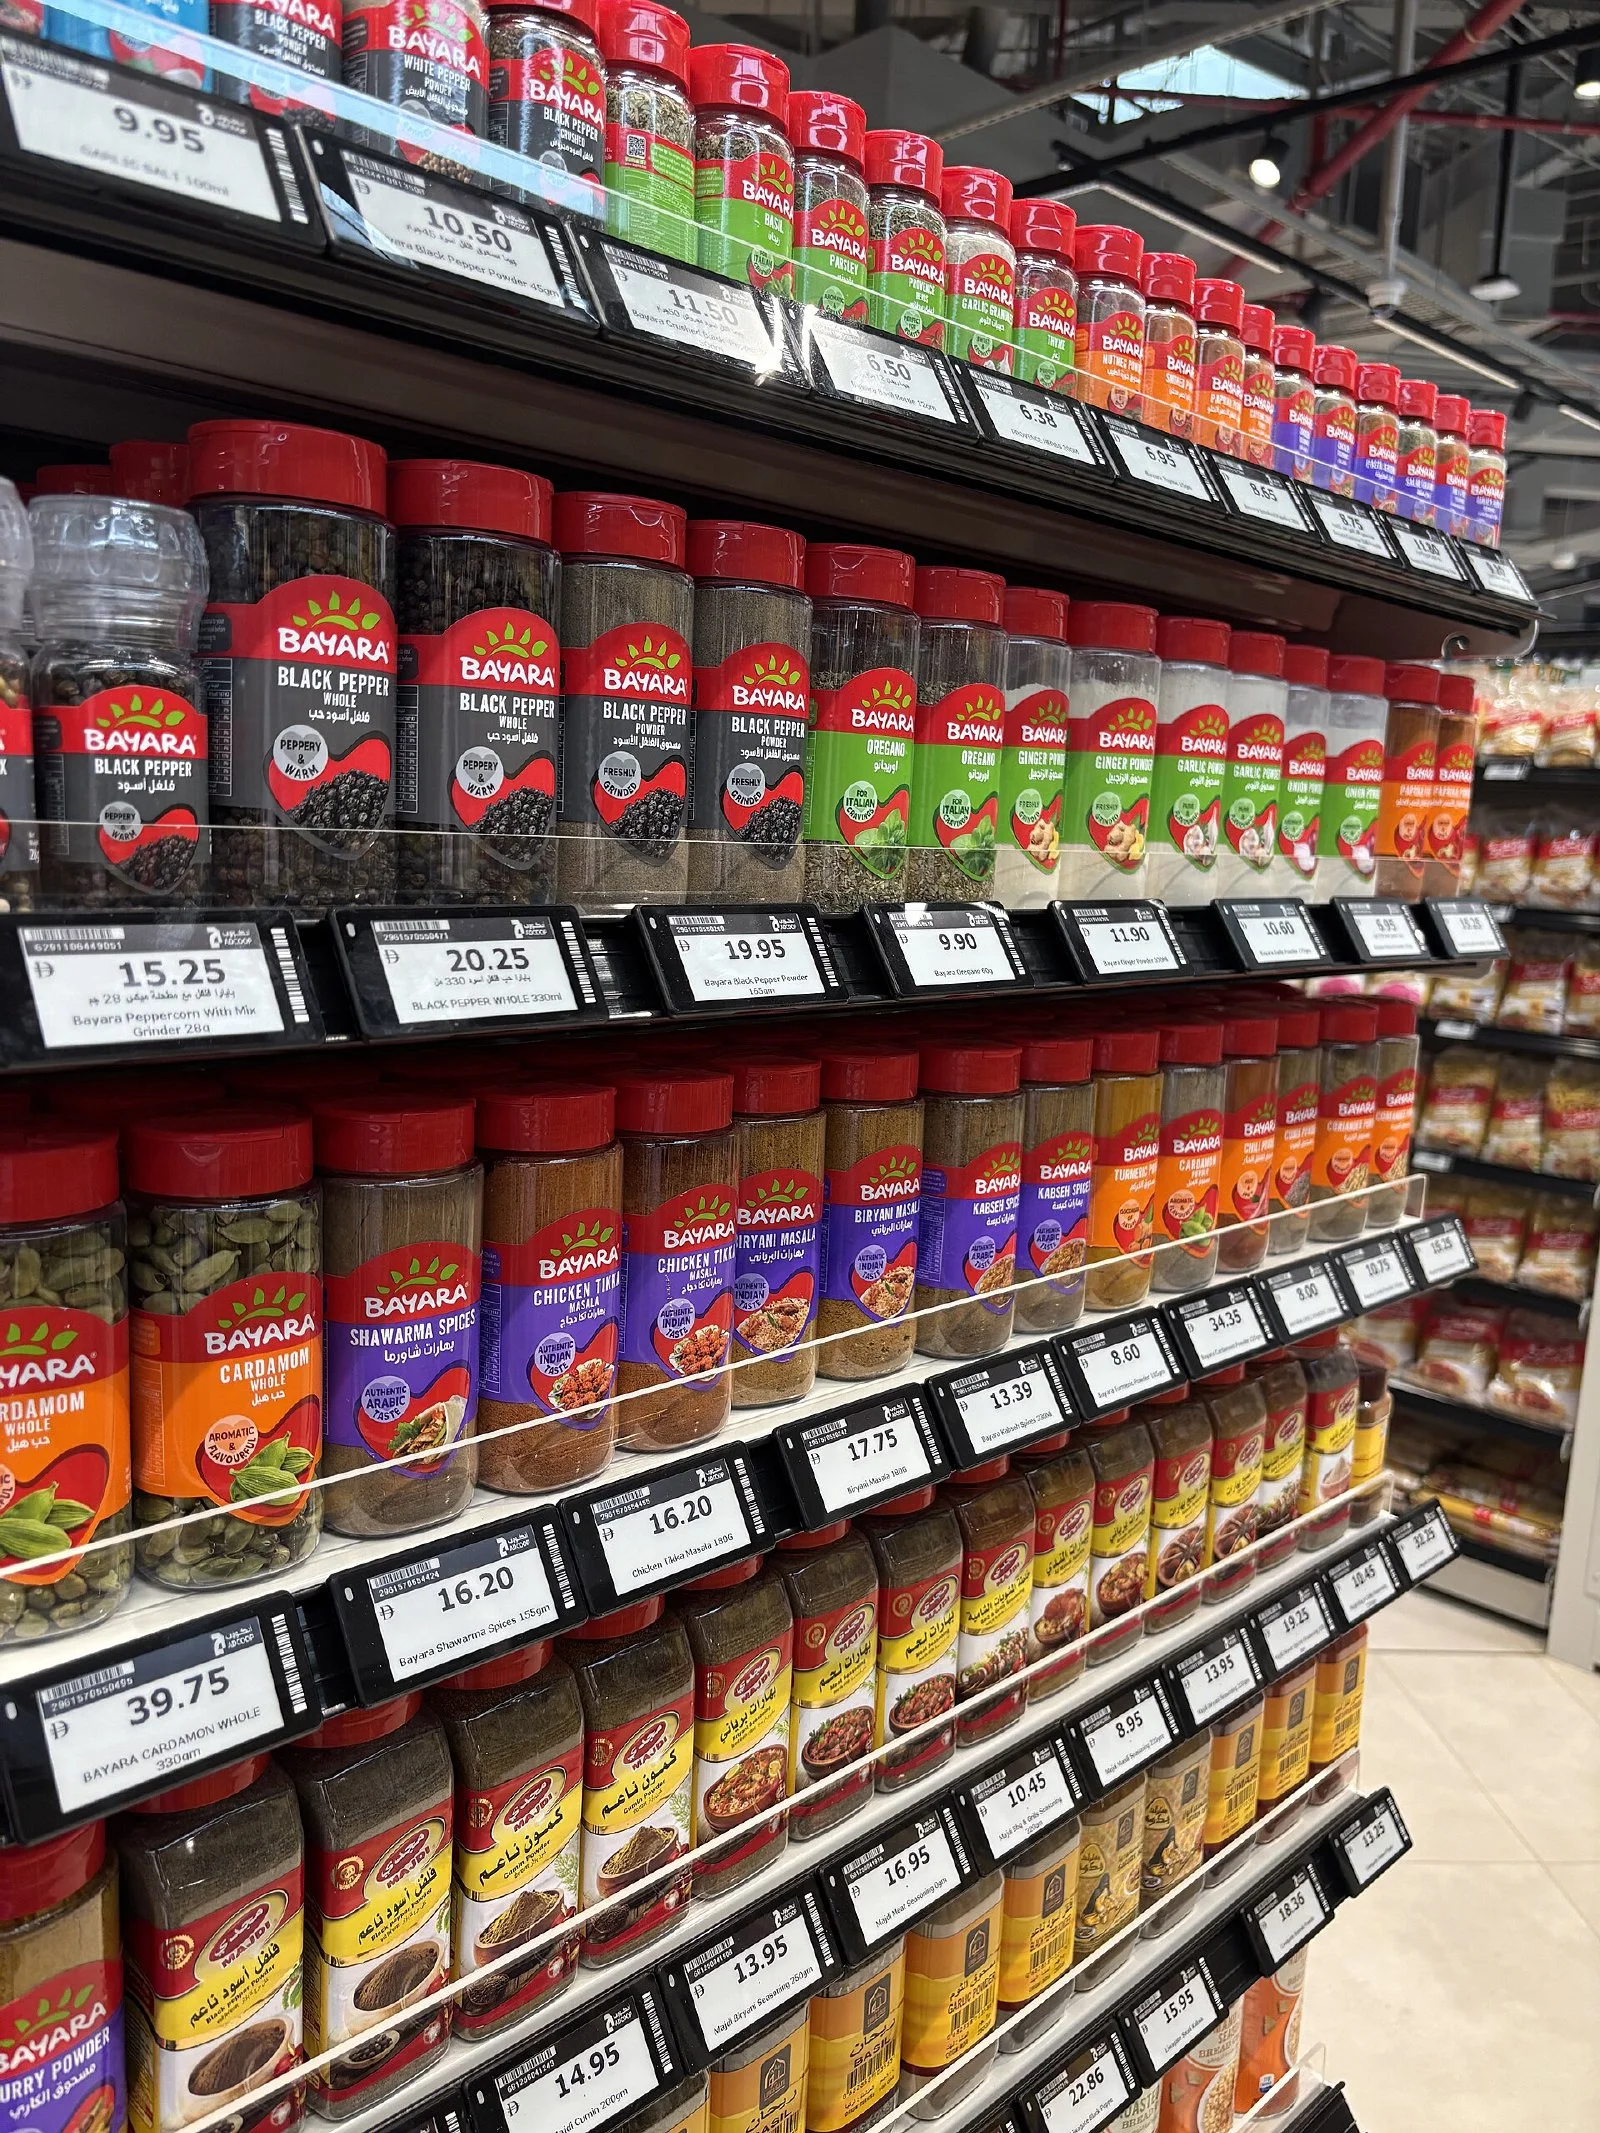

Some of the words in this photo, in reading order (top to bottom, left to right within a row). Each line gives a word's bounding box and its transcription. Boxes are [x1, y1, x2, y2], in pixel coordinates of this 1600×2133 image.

[255, 9, 290, 34] BLACK
[290, 24, 327, 51] PEPPER
[388, 25, 482, 80] BAYARA
[404, 54, 435, 77] WHITE
[435, 63, 471, 92] PEPPER
[529, 79, 605, 130] BAYARA
[113, 106, 205, 154] 9.95
[543, 107, 570, 130] BLACK
[572, 116, 599, 142] PEPPER
[560, 127, 586, 150] CRUSHED
[424, 206, 513, 253] 10.50
[765, 211, 783, 234] BASIL
[811, 228, 867, 264] BAYARA
[416, 244, 445, 261] Black
[448, 255, 485, 274] Pepper
[489, 267, 528, 287] Powder
[829, 255, 859, 276] PARSLEY
[891, 253, 945, 285] BAYARA
[668, 289, 740, 327] 11.50
[1029, 311, 1076, 338] BAYARA
[867, 354, 912, 381] 6.50
[1019, 403, 1057, 429] 6.38
[1146, 446, 1177, 470] 6.95
[1251, 482, 1277, 503] 8.65
[278, 627, 389, 664] BAYARA
[278, 667, 333, 690] BLACK
[339, 672, 390, 697] PEPPER
[460, 656, 555, 688] BAYARA
[603, 668, 687, 697] BAYARA
[323, 692, 357, 709] WHOLE
[460, 693, 507, 714] BLACK
[512, 697, 555, 718] PEPPER
[732, 685, 805, 711] BAYARA
[499, 715, 527, 730] WHOLE
[603, 701, 645, 721] BLACK
[650, 706, 687, 726] PEPPER
[851, 708, 914, 732] BAYARA
[636, 723, 665, 736] POWDER
[732, 716, 771, 735] BLACK
[774, 718, 805, 739] PEPPER
[1099, 731, 1154, 750] BAYARA
[84, 728, 196, 755] BAYARA
[280, 739, 322, 752] PEPPERY
[760, 736, 787, 749] POWDER
[867, 739, 905, 757] OREGANO
[1181, 736, 1227, 755] BAYARA
[94, 758, 140, 776] BLACK
[144, 760, 192, 777] PEPPER
[463, 759, 498, 771] PEPPERY
[961, 750, 996, 766] OREGANO
[1018, 751, 1047, 765] GINGER
[1095, 755, 1127, 770] GINGER
[1177, 759, 1206, 775] GARLIC
[284, 763, 318, 780] WARM
[603, 767, 636, 778] FRESHLY
[731, 777, 761, 788] FRESHLY
[1233, 765, 1261, 780] GARLIC
[467, 783, 495, 798] WARM
[845, 798, 876, 808] ITALIAN
[1109, 925, 1151, 944] 11.90
[1262, 920, 1295, 937] 10.60
[723, 938, 787, 961] 19.95
[938, 932, 978, 952] 9.90
[446, 948, 529, 972] 20.25
[119, 959, 226, 988] 15.25
[412, 1001, 447, 1011] BLACK
[450, 998, 491, 1009] PEPPER
[493, 995, 530, 1005] WHOLE
[531, 993, 563, 1003] 330ml
[73, 1014, 122, 1026] Bayara
[126, 1010, 201, 1025] Peppercorn
[203, 1007, 232, 1018] With
[234, 1006, 256, 1016] Mix
[1173, 1138, 1220, 1154] BAYARA
[1040, 1161, 1092, 1180] BAYARA
[860, 1178, 920, 1202] BAYARA
[1038, 1184, 1070, 1199] KABSEH
[737, 1204, 814, 1226] BAYARA
[854, 1206, 894, 1224] BIRYANI
[973, 1201, 1004, 1215] KABSEH
[664, 1221, 735, 1249] BAYARA
[780, 1227, 816, 1244] MASALA
[1037, 1233, 1060, 1244] ARABIC
[538, 1245, 619, 1279] BAYARA
[658, 1252, 710, 1274] CHICKEN
[364, 1283, 468, 1318] BAYARA
[569, 1296, 600, 1314] MASALA
[350, 1322, 434, 1347] SHAWARMA
[438, 1308, 476, 1336] SPICES
[1208, 1309, 1242, 1333] 34.35
[204, 1314, 315, 1355] BAYARA
[219, 1348, 309, 1384] CARDAMOM
[539, 1350, 572, 1365] INDIAN
[1110, 1343, 1141, 1367] 8.60
[250, 1373, 286, 1392] WHOLE
[365, 1386, 407, 1397] AUTHENTIC
[989, 1381, 1033, 1410] 13.39
[366, 1395, 406, 1408] ARABIC
[5, 1418, 51, 1437] WHOLE
[372, 1408, 402, 1422] TASTE
[208, 1425, 255, 1442] AROMATIC
[847, 1428, 898, 1462] 17.75
[649, 1495, 712, 1535] 16.20
[632, 1562, 663, 1578] Chicken
[686, 1543, 712, 1558] Masala
[714, 1533, 734, 1546] 180G
[438, 1567, 514, 1612] 16.20
[1282, 1608, 1311, 1634] 19.25
[399, 1648, 435, 1667] Bayara
[436, 1628, 486, 1653] Shawarma
[488, 1616, 517, 1633] Spices
[519, 1604, 551, 1622] 155gm
[1204, 1654, 1235, 1684] 13.95
[127, 1666, 229, 1727] 39.75
[1114, 1711, 1144, 1740] 8.95
[83, 1755, 139, 1784] BAYARA
[142, 1724, 215, 1761] CARDAMON
[217, 1706, 261, 1731] WHOLE
[632, 1736, 668, 1771] MAJDI
[641, 1750, 678, 1791] كمون
[601, 1780, 639, 1819] ناعم
[1007, 1772, 1047, 1809] 10.45
[513, 1793, 553, 1832] MAJDI
[522, 1807, 564, 1852] كمون
[386, 1846, 431, 1889] MAJDI
[478, 1844, 521, 1886] ناعم
[884, 1845, 930, 1887] 16.95
[875, 1911, 891, 1928] Majdi
[906, 1885, 934, 1908] Seasoning
[1278, 1892, 1307, 1922] 18.36
[220, 1921, 272, 1969] MAJDI
[733, 1934, 789, 1984] 13.95
[1162, 1990, 1196, 2024] 15.95
[850, 2018, 895, 2058] ريحان
[854, 2038, 891, 2067] BASIL
[555, 2041, 620, 2099] 14.95
[1067, 2066, 1105, 2107] 22.86
[574, 2107, 600, 2126] Cumin
[600, 2088, 629, 2110] 200gm
